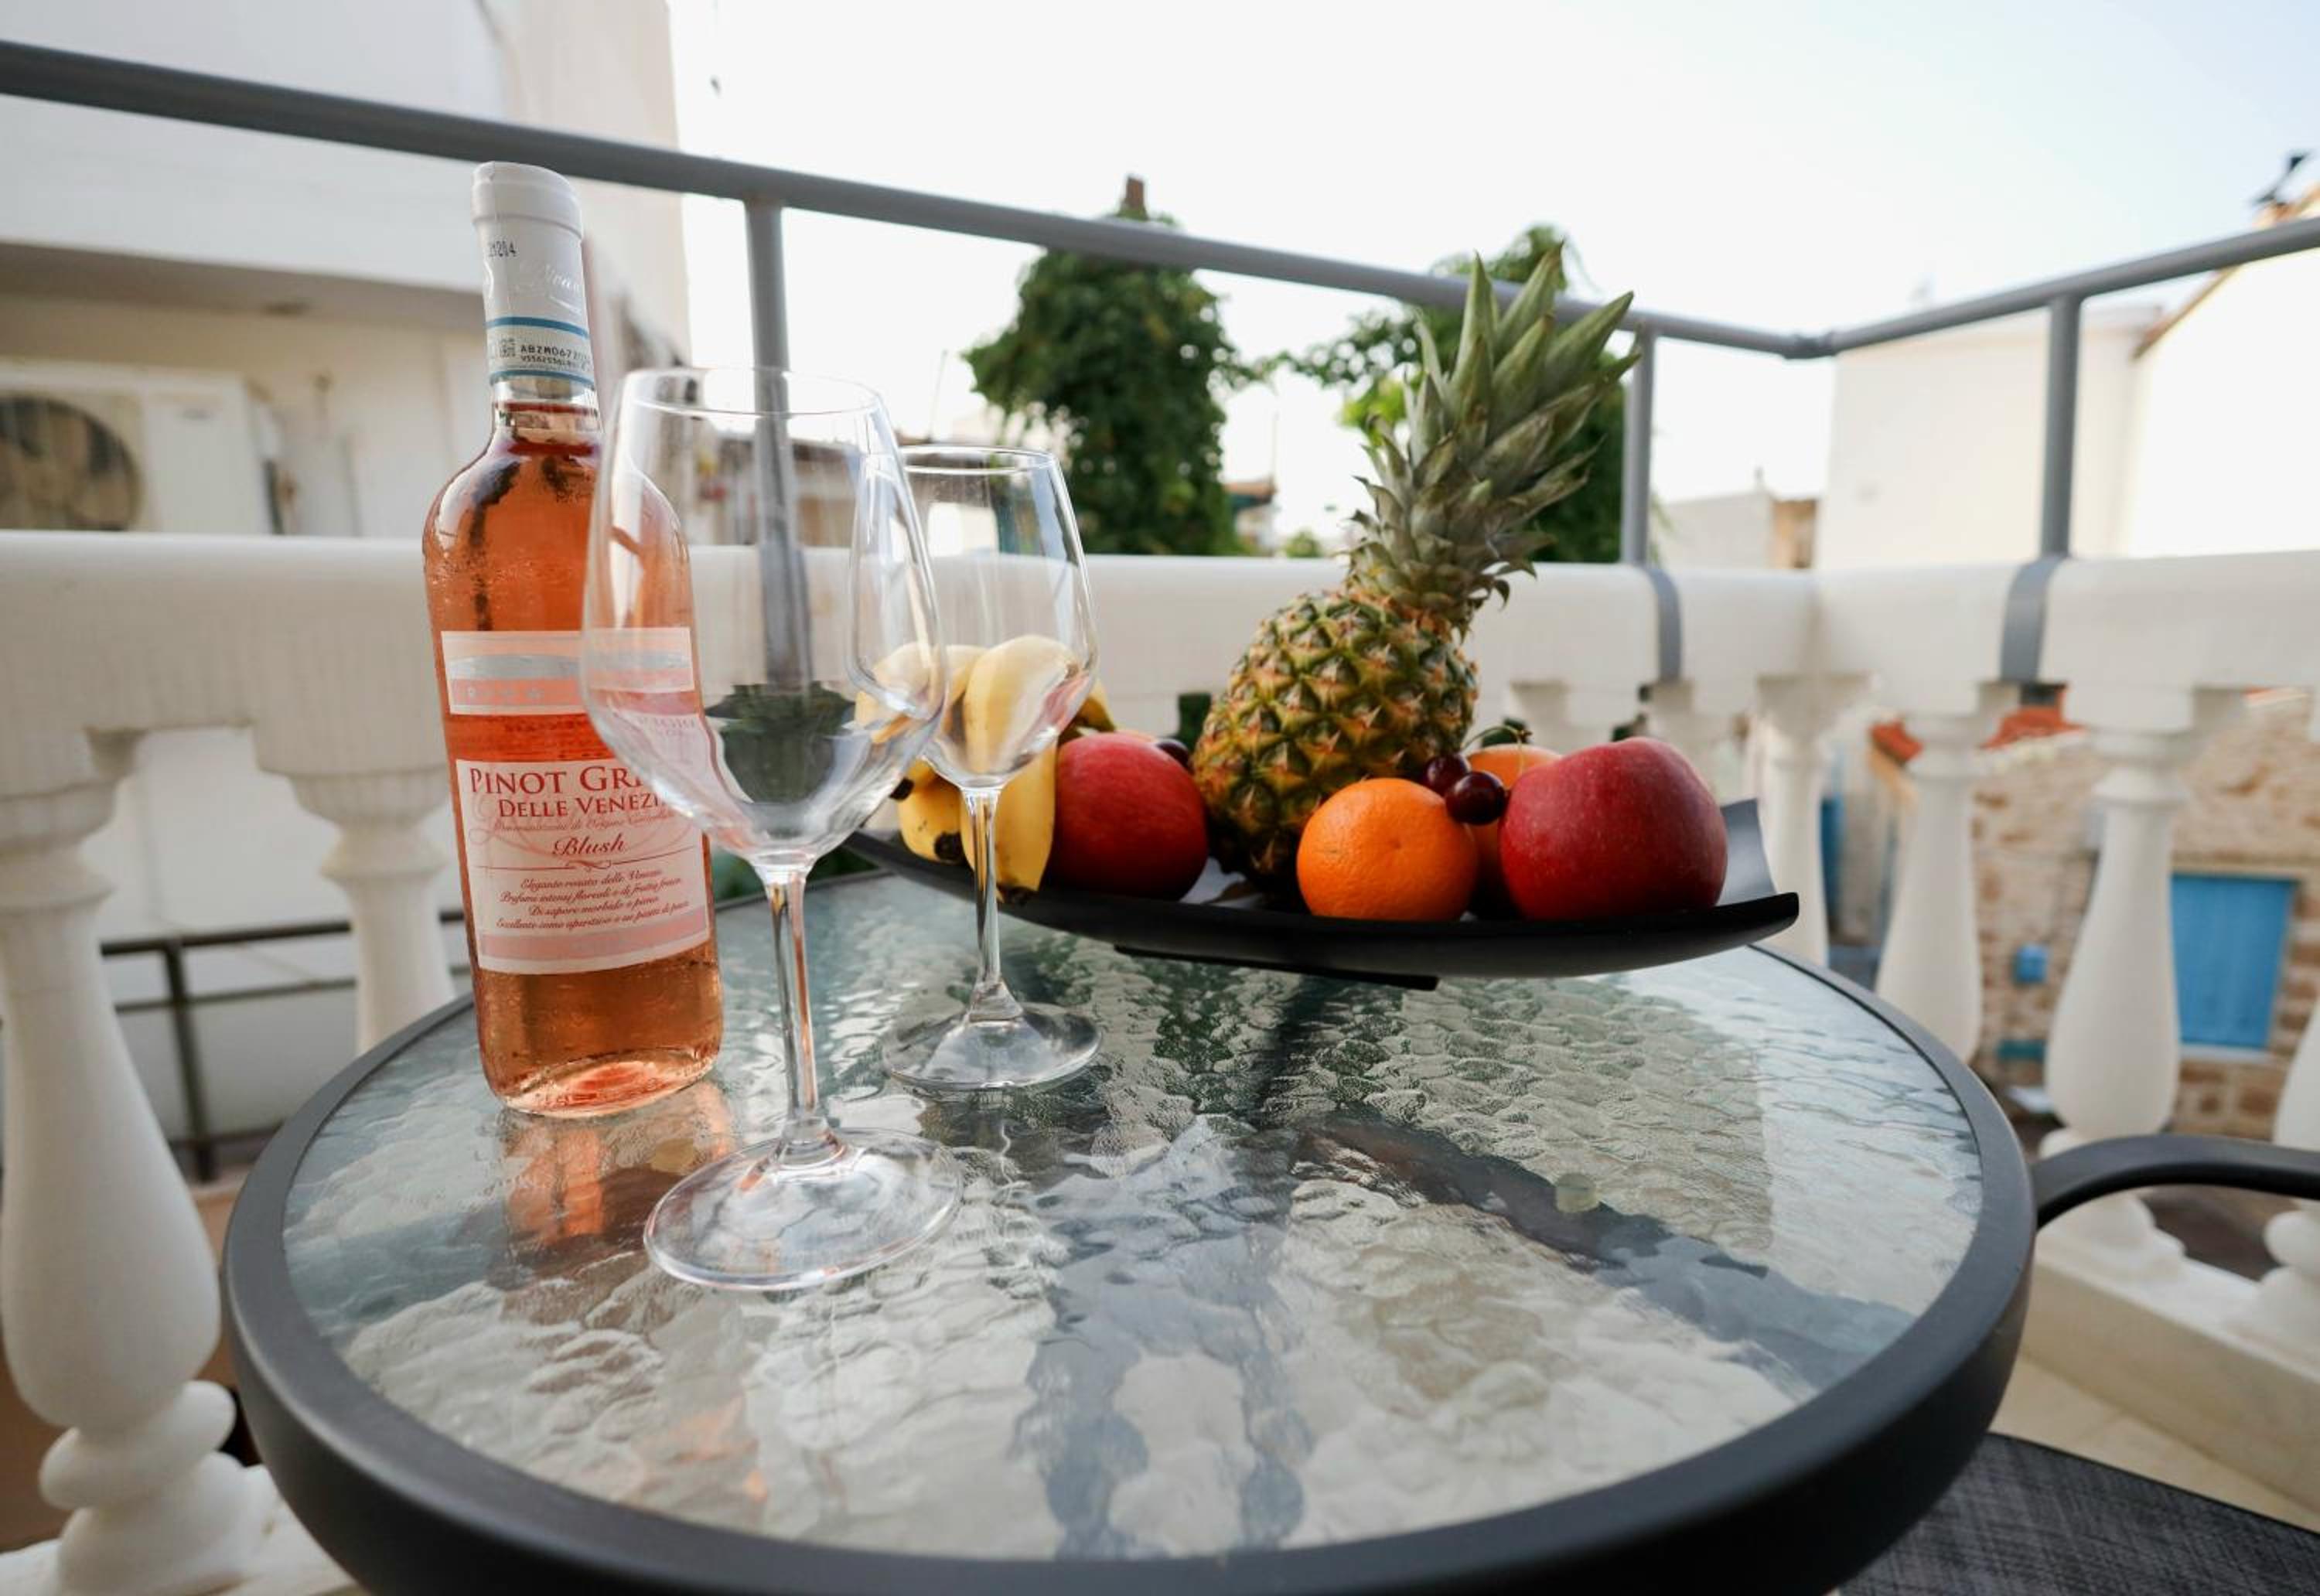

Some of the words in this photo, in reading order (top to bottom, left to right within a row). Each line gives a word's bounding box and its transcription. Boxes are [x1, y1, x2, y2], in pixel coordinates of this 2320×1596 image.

[470, 768, 567, 794] PINOT
[580, 766, 643, 792] GRI
[499, 799, 568, 817] DELLE
[575, 791, 669, 815] VENEZI
[552, 833, 624, 855] Blush
[520, 878, 563, 892] Elegante
